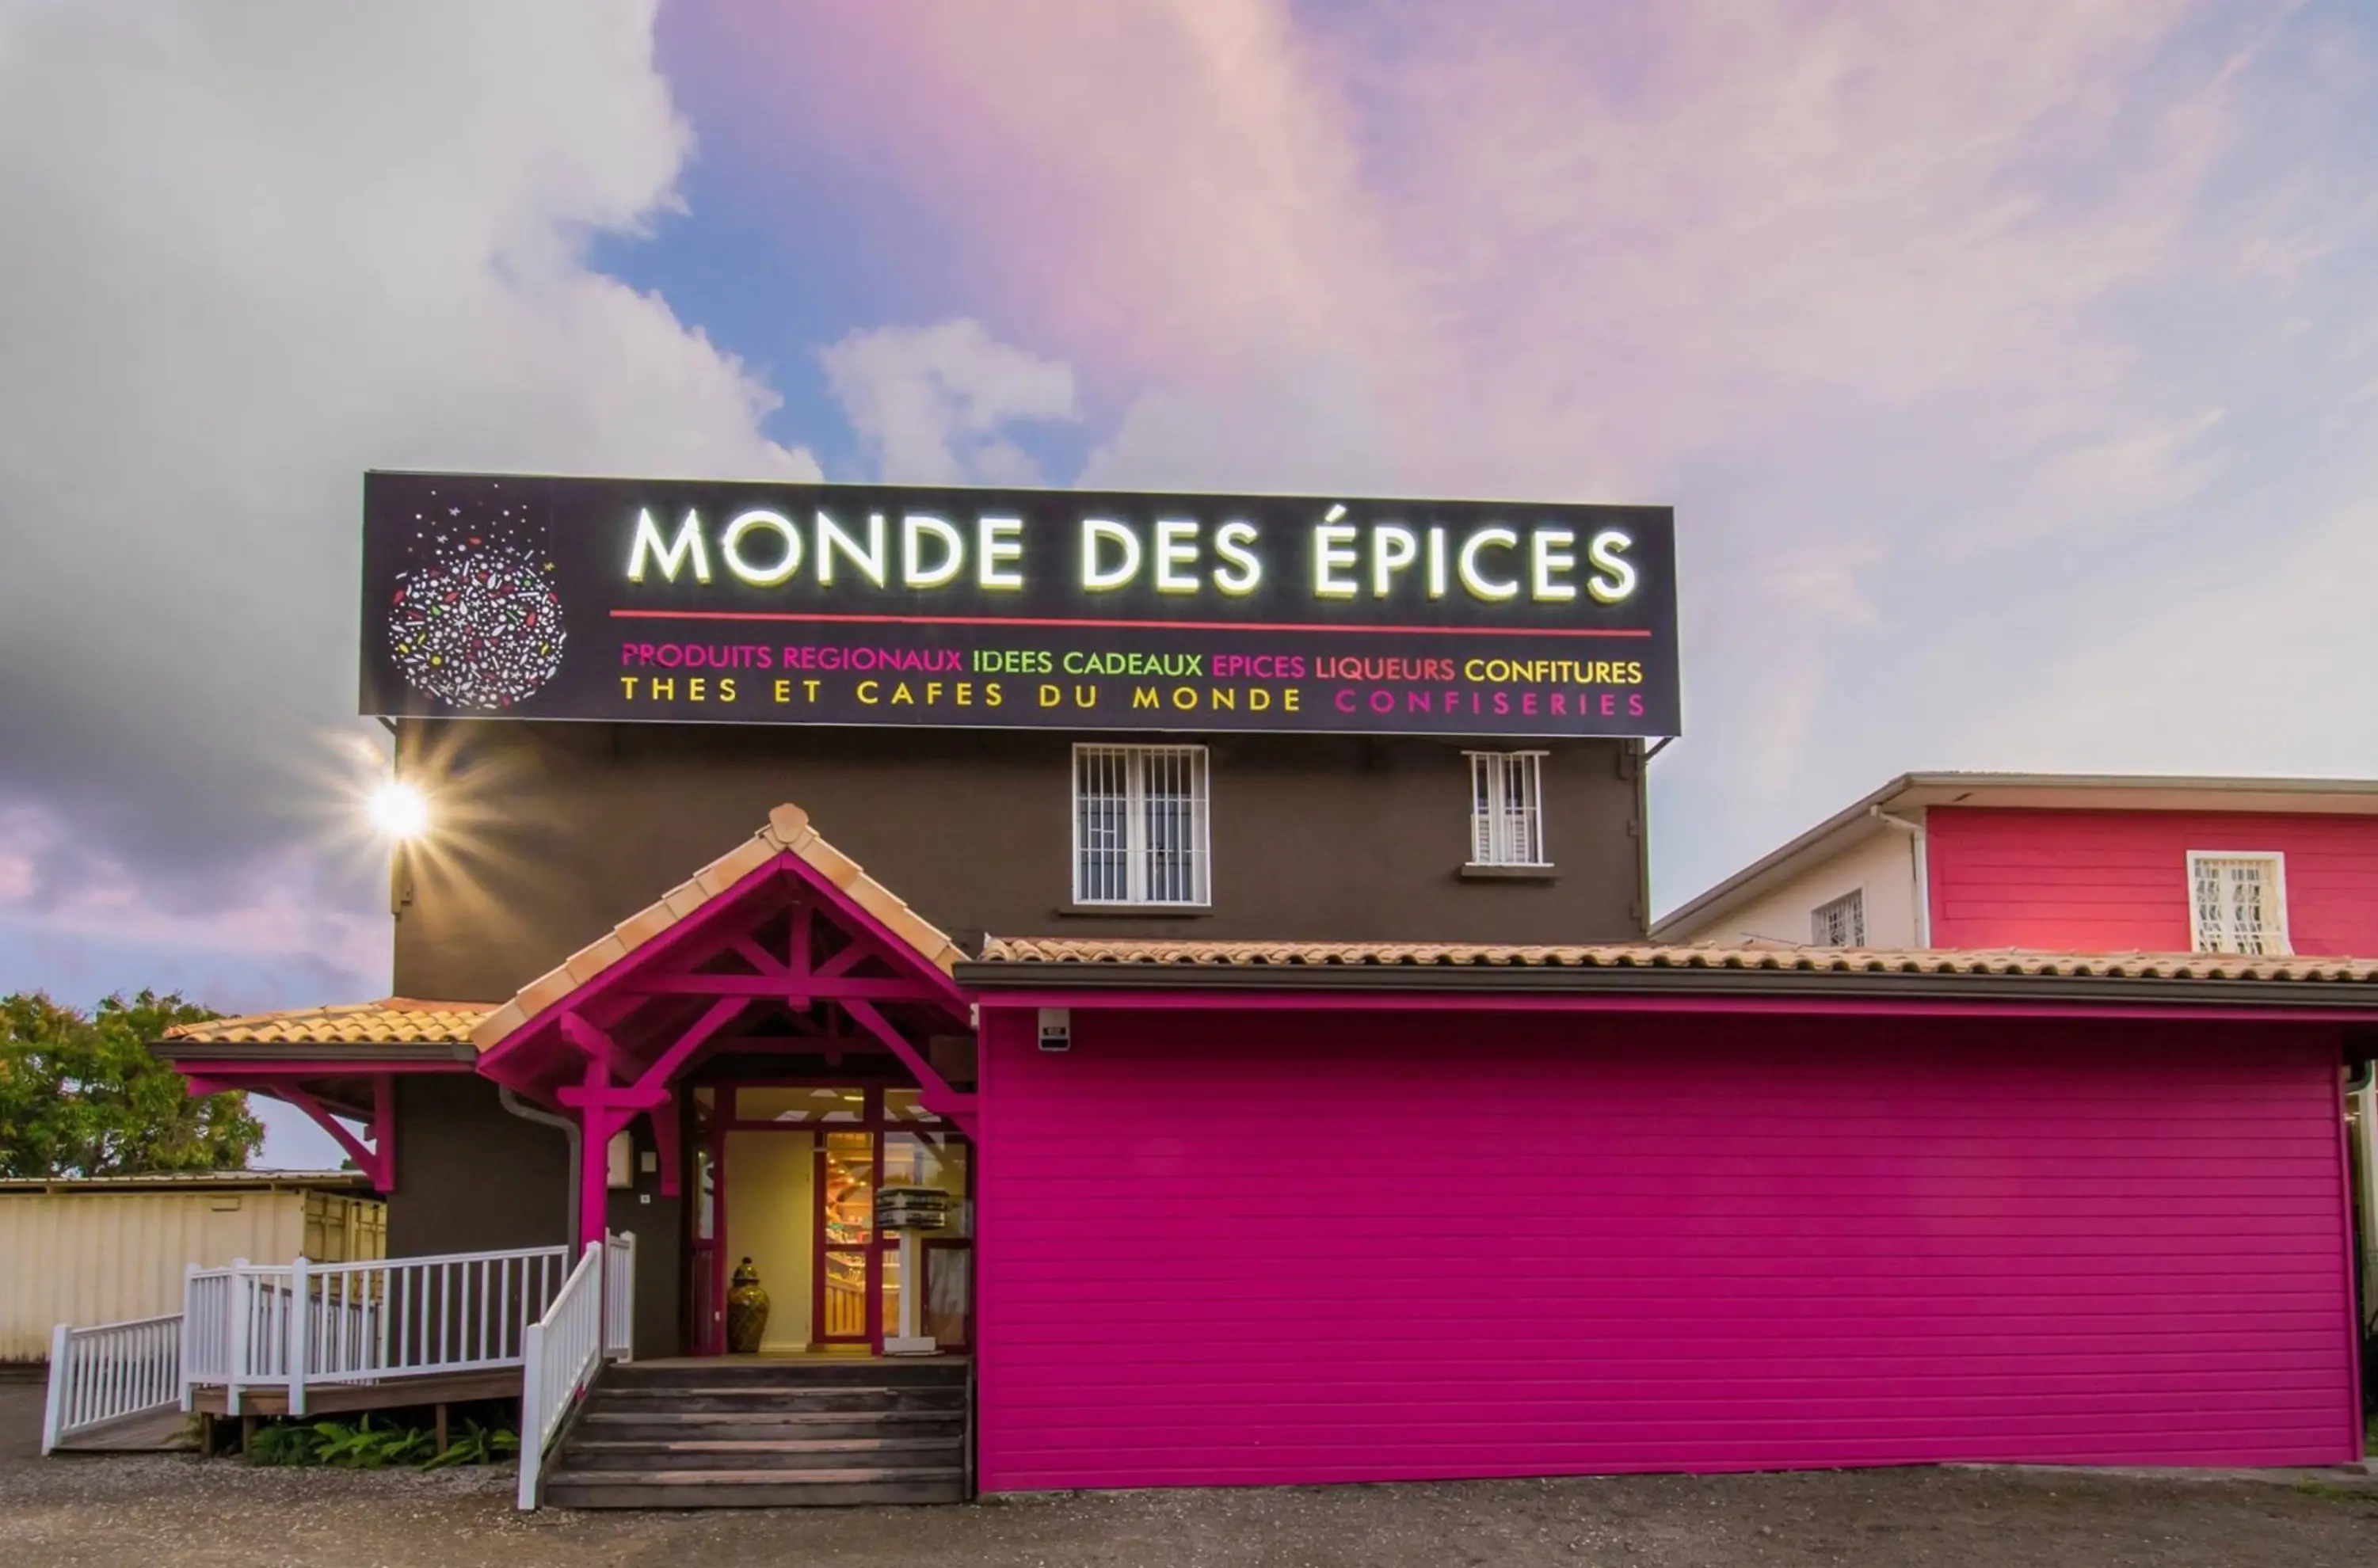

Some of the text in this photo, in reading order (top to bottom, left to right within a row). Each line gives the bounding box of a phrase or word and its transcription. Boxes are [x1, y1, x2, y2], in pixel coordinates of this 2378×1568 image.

[627, 504, 1637, 603] MONDE DES ÉPICES
[621, 643, 1642, 684] PRODUITS REGIONAUX IDEES CADEAUX EPICES LIQUEURS CONFITURES
[620, 677, 1644, 716] THES ET CAFES DU MONDE CONFISERIES
